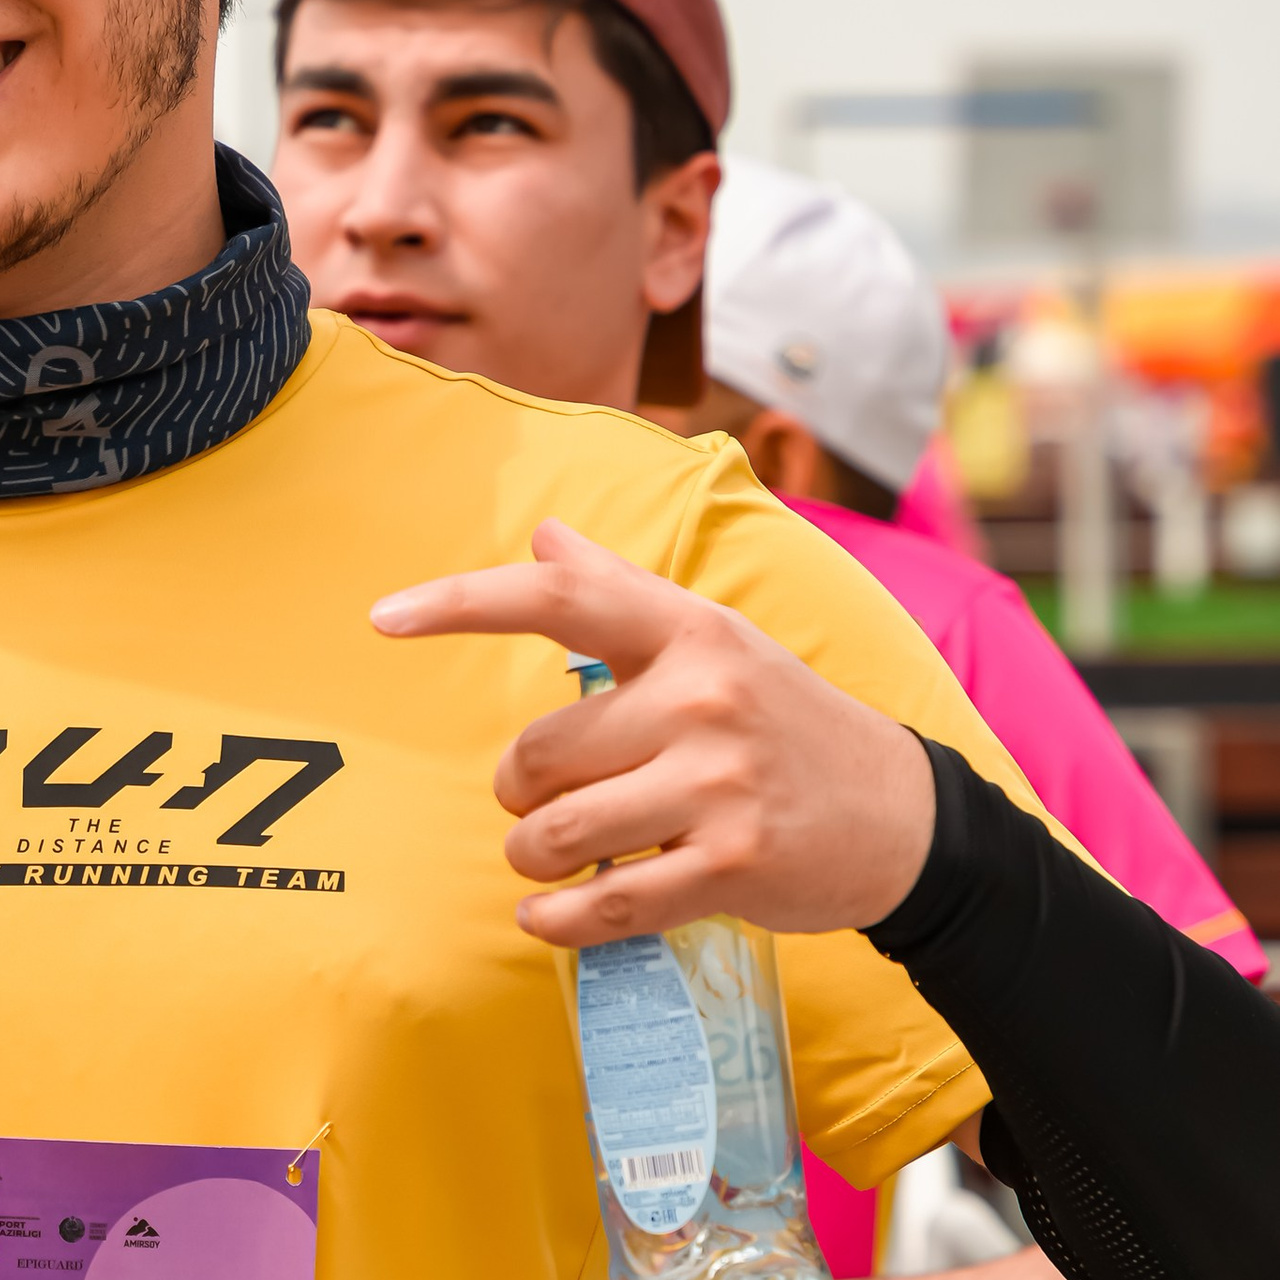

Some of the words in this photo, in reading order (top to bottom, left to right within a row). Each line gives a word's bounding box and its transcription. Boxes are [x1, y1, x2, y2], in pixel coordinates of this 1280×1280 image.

[69, 818, 121, 833] THE
[17, 838, 171, 854] DISTANCE
[23, 865, 209, 886] RUNNING
[236, 867, 342, 891] TEAM
[17, 1258, 83, 1270] EPIGUARD
